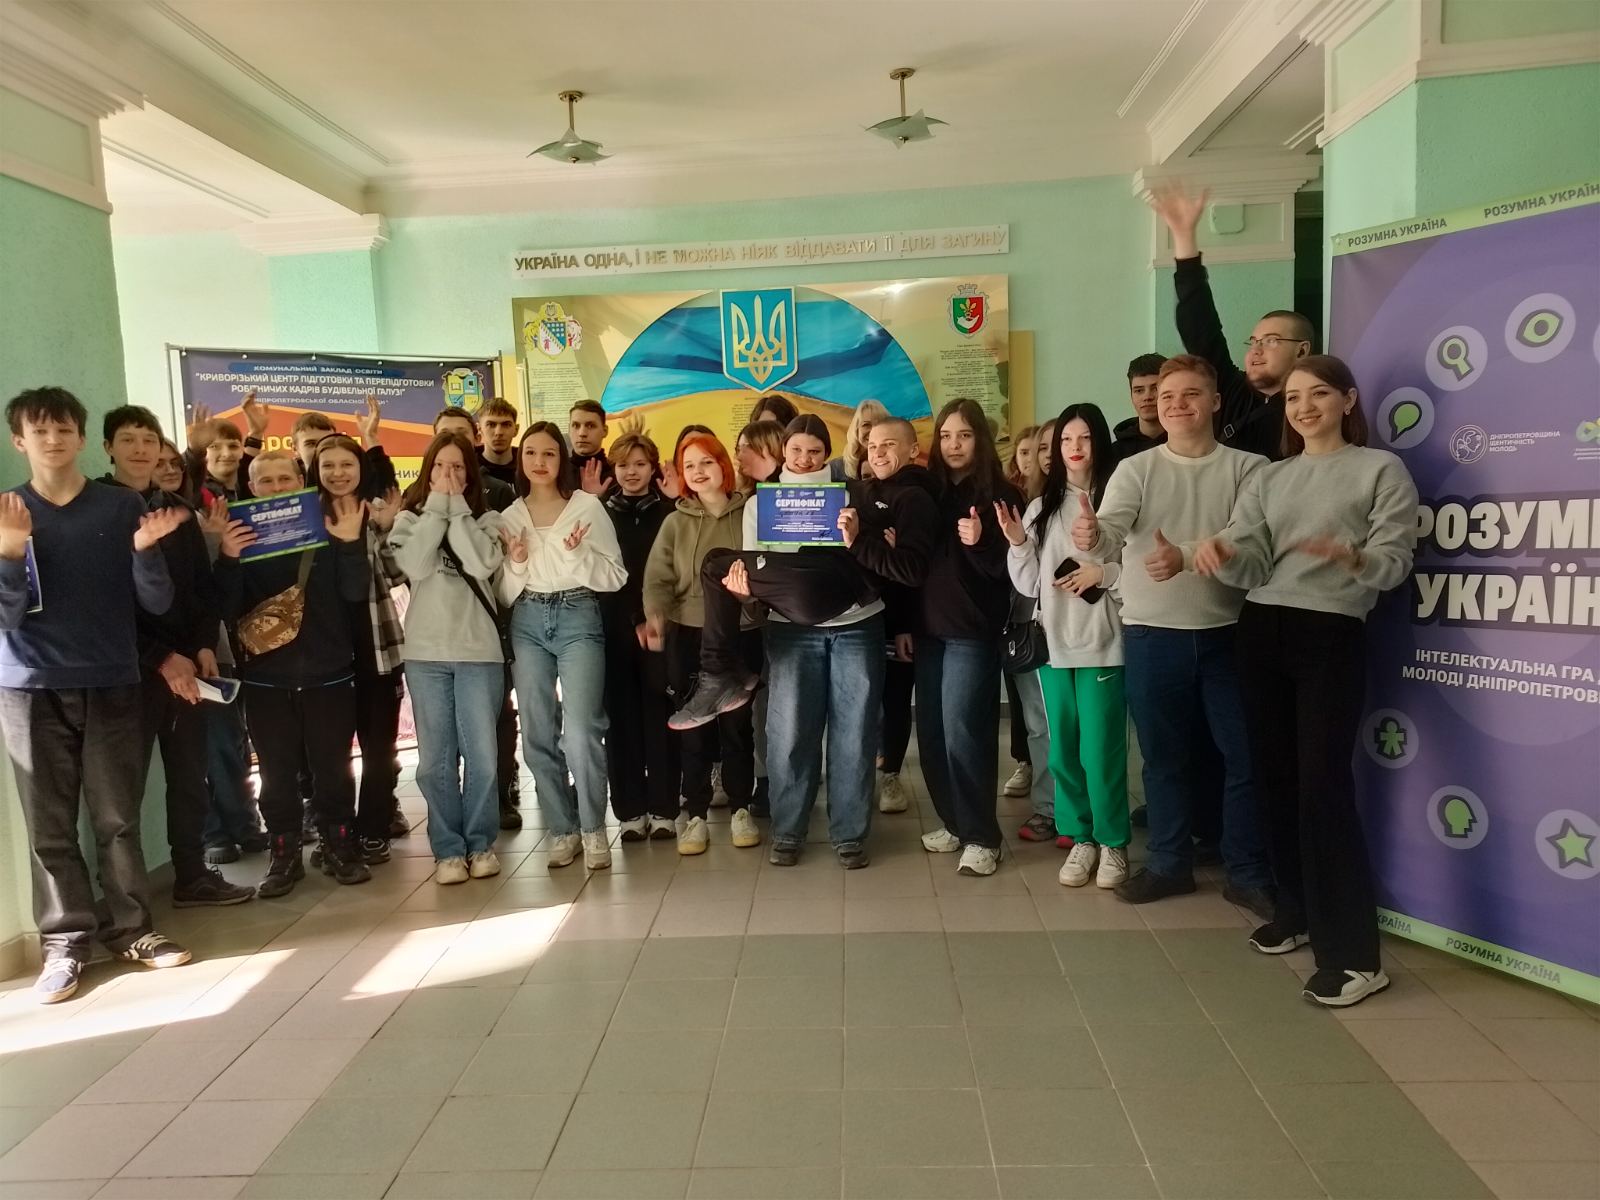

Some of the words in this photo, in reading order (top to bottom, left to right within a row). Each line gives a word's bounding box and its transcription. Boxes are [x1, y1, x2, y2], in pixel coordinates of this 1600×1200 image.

[1484, 196, 1547, 219] РОЗУМНА
[1549, 183, 1600, 205] УКРАЇН
[1347, 228, 1398, 248] РОЗУМНА
[1399, 217, 1448, 238] УКРАЇНА
[514, 252, 580, 271] УКРАЇНА
[583, 249, 633, 269] ОДНА,
[646, 249, 668, 265] НЕ
[673, 246, 736, 265] МОЖНА
[784, 238, 877, 260] ВІДДАВАТИ
[900, 234, 936, 252] ДЛЯ
[195, 372, 269, 383] "КРИВОРІЗЬКИЙ
[270, 374, 299, 384] ЦЕНТР
[300, 375, 353, 385] ПІДГОТОВКИ
[354, 377, 365, 385] ТА
[366, 377, 435, 388] ПЕРЕПІДГОТОВКИ
[289, 385, 320, 395] КАДРІВ
[321, 386, 376, 396] БУДІВЕЛЬНОЇ
[775, 498, 826, 508] СЕРТИФІКАТ
[1414, 562, 1600, 627] УКРАЇН
[1416, 648, 1558, 678] ІНТЕЛЕКТУАЛЬНА
[1561, 665, 1595, 682] ГРА
[1402, 665, 1463, 687] МОЛОДІ
[1466, 673, 1600, 704] ДНІПРОПЕТРОВ
[1377, 914, 1412, 934] КРАЇНА
[1445, 936, 1503, 965] РОЗУМНА
[1506, 956, 1561, 984] УКРАЇНА
